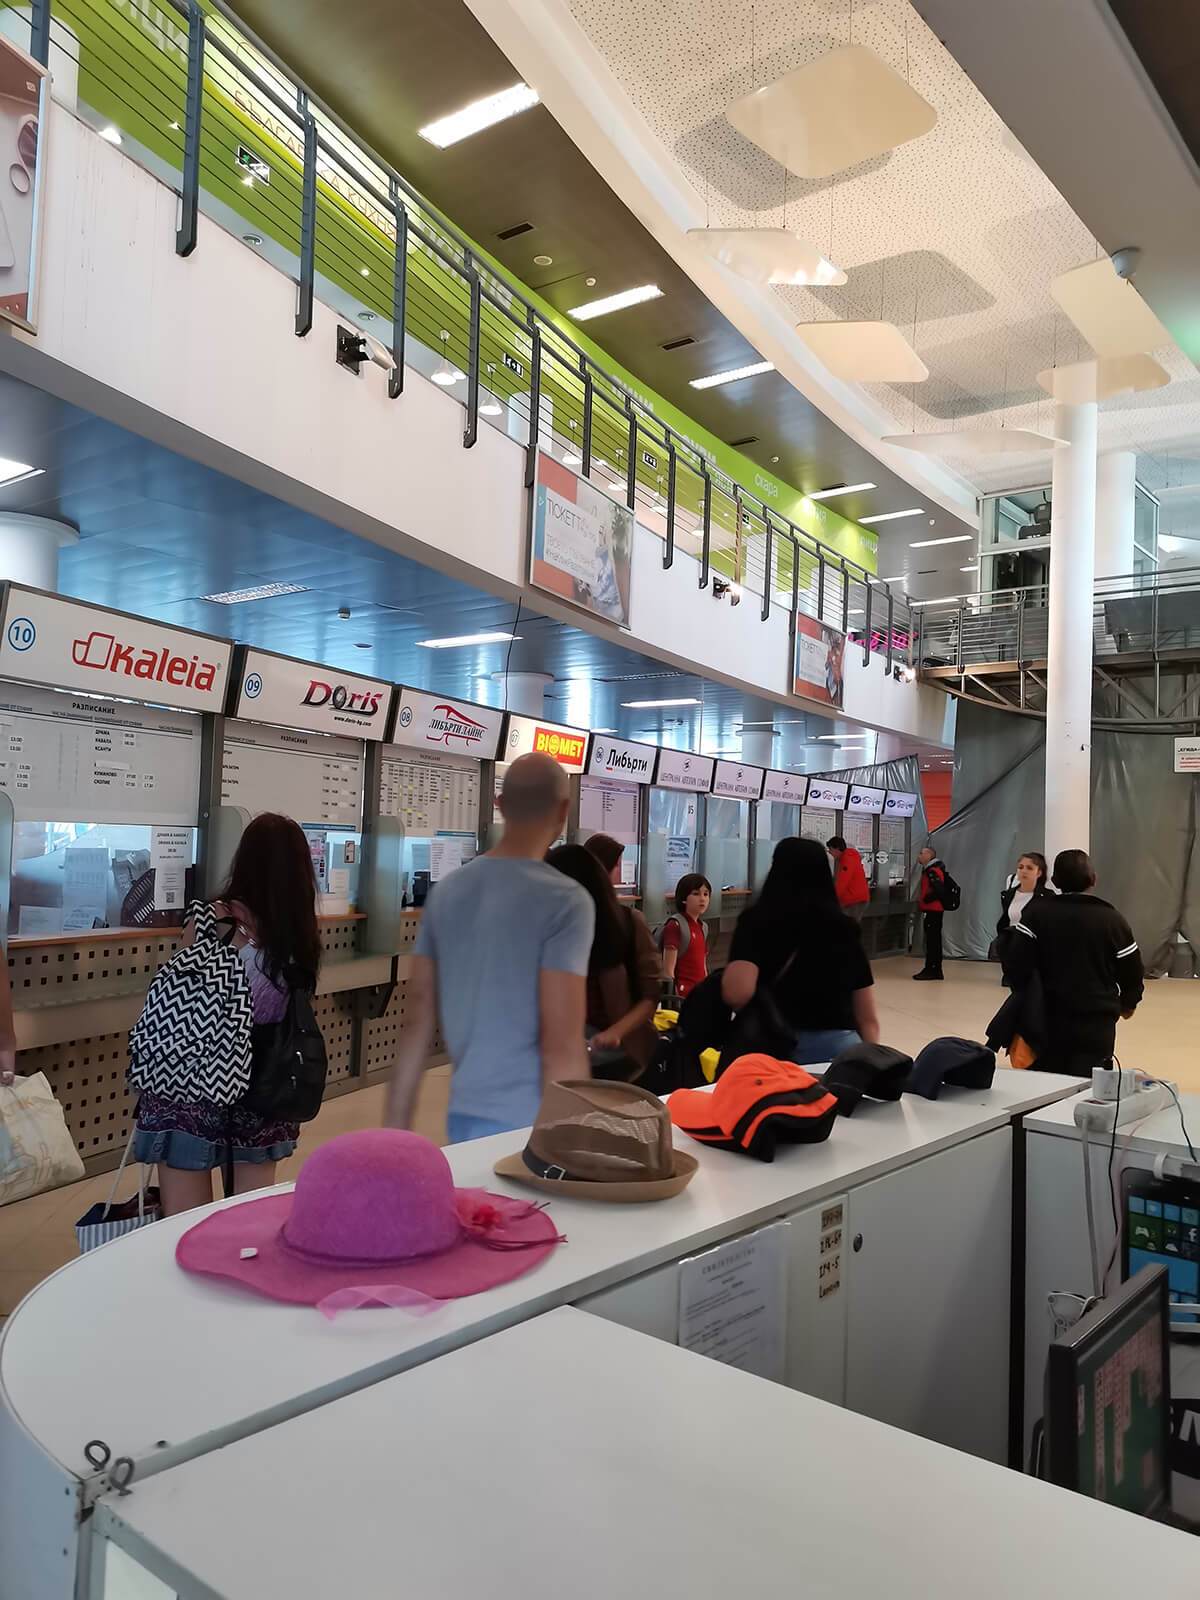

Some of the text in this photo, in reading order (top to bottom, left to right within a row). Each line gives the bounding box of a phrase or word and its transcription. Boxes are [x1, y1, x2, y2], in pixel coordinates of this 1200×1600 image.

[14, 626, 31, 643] 10
[246, 682, 260, 692] 09
[72, 702, 116, 714] РАЗПИСАНИЕ
[401, 711, 411, 724] 08
[607, 748, 648, 774] Либърти
